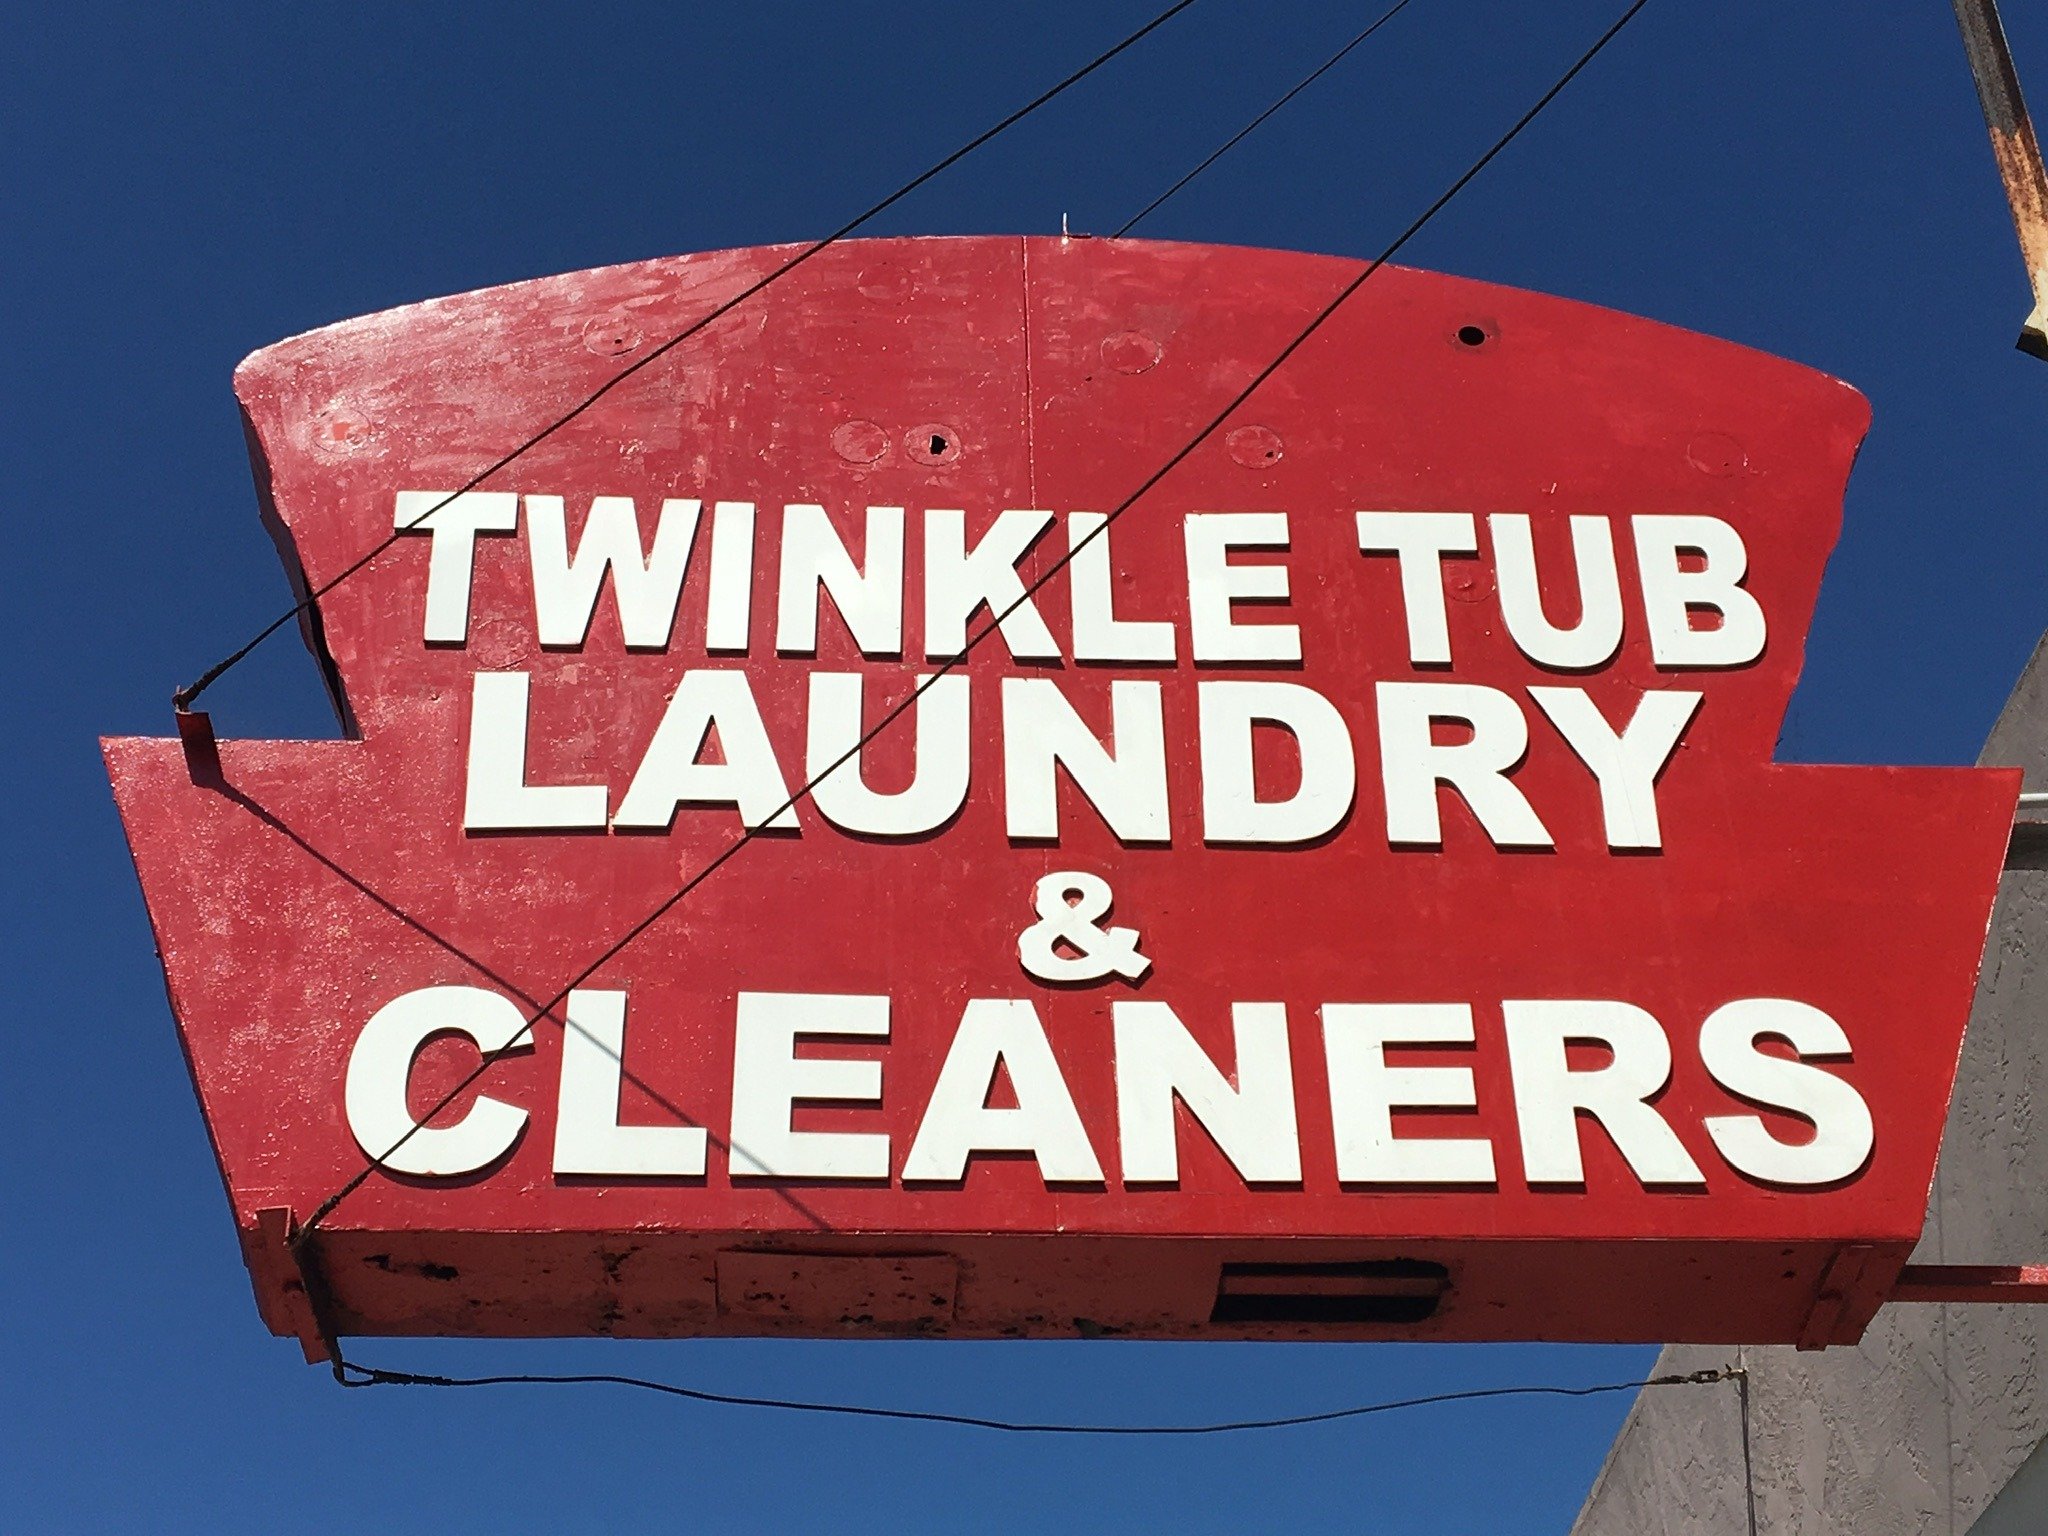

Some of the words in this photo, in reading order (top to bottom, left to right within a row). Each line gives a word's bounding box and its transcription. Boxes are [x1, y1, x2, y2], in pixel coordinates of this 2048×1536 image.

[394, 490, 1303, 662] TWINKLE
[1356, 510, 1767, 668] TUB
[460, 668, 1704, 849] LAUNDRY
[1017, 870, 1152, 983] &
[344, 985, 1874, 1187] CLEANERS
